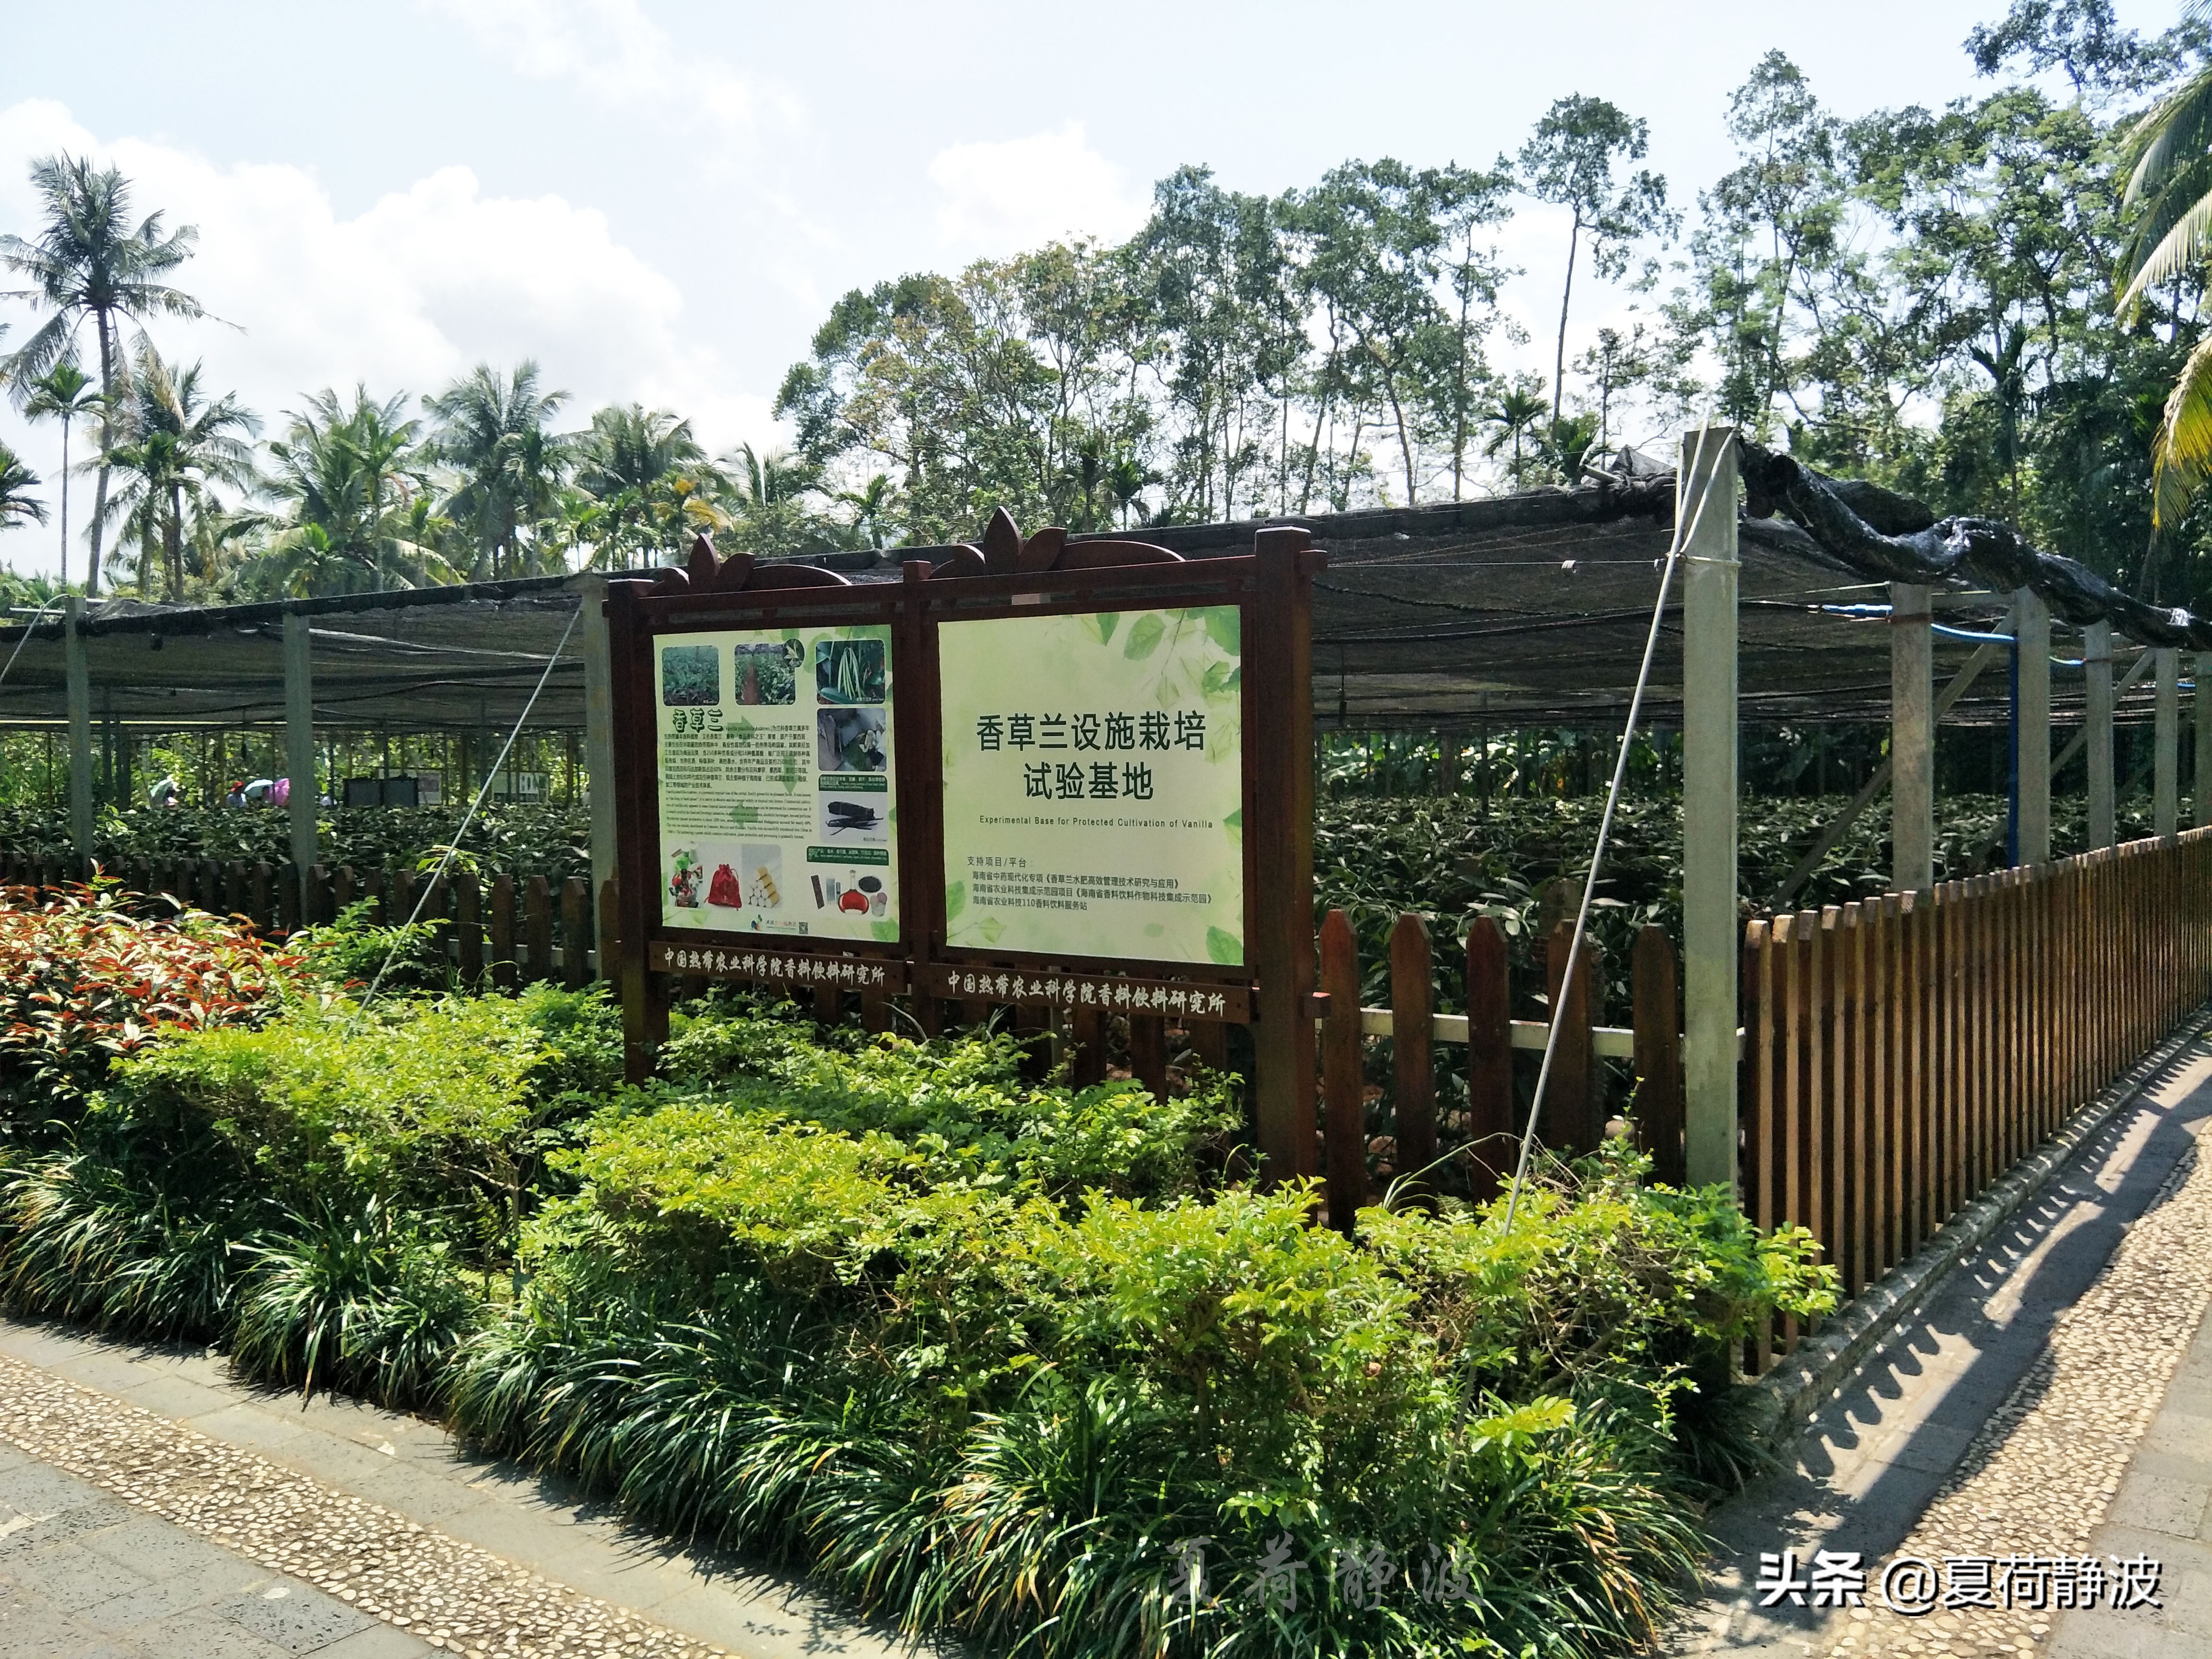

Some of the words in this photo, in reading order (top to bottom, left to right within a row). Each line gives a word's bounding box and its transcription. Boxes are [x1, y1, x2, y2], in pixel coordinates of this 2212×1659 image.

[673, 708, 723, 733] 香草兰
[976, 709, 1206, 751] 香草兰设施栽培
[1023, 761, 1154, 800] 试验基地
[979, 815, 1031, 825] Experimental
[1034, 817, 1054, 825] Base
[1058, 817, 1069, 825] for
[1072, 817, 1114, 826] Protected
[1118, 818, 1165, 827] Cultivation
[1169, 819, 1178, 828] of
[1182, 819, 1213, 828] Vanilla
[973, 895, 1087, 911] 海南省农业科技110香料饮料服务站
[664, 947, 886, 987] 中国热带农业科学院香料饮料研究所
[948, 970, 1226, 1017] 中国热带农业科学院香料饮料研究所
